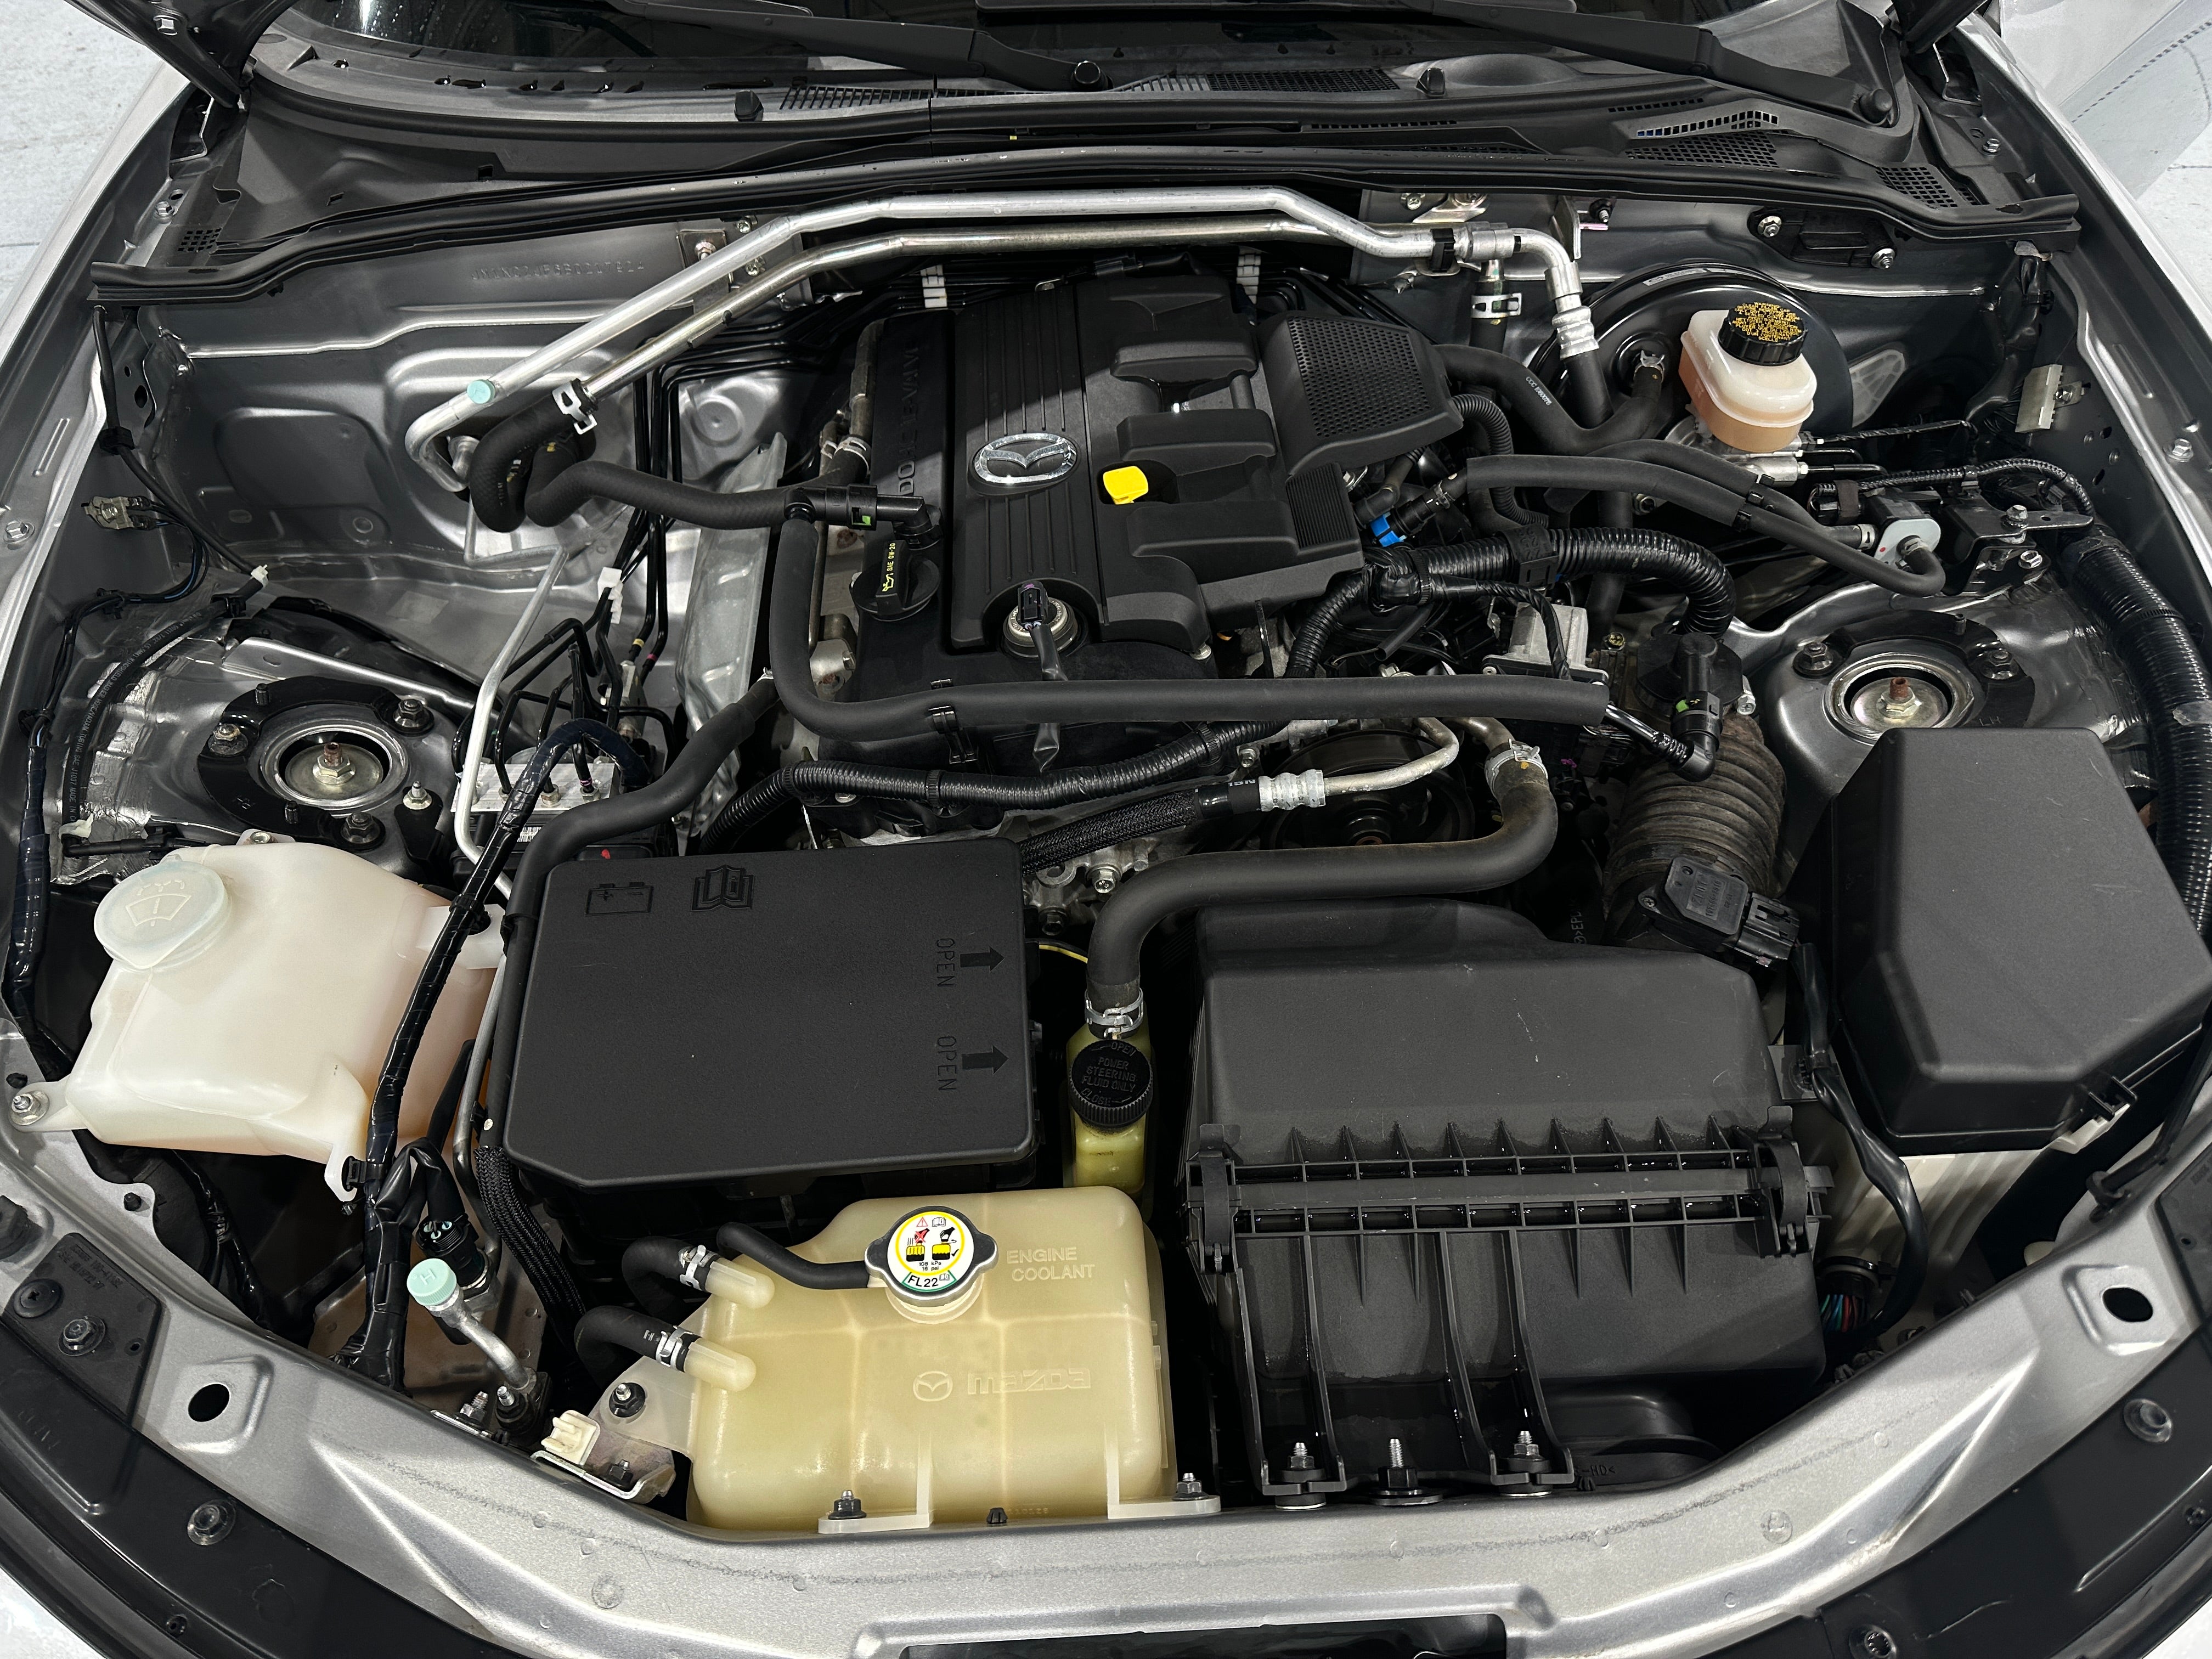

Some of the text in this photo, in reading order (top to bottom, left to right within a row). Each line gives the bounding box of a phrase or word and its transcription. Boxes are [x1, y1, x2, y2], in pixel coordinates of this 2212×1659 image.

[1979, 715, 2001, 726] LH
[936, 938, 956, 987] OPEN
[1110, 1041, 1137, 1057] OPEN
[936, 1035, 957, 1091] OPEN
[1098, 1057, 1130, 1070] POWER
[1086, 1065, 1136, 1082] STEERING
[1081, 1075, 1136, 1093] FLUID ONLY
[1081, 1087, 1111, 1107] CLOSE
[1006, 1246, 1077, 1265] ENGINE
[907, 1274, 939, 1288] FL22
[1011, 1263, 1096, 1282] COOLANT
